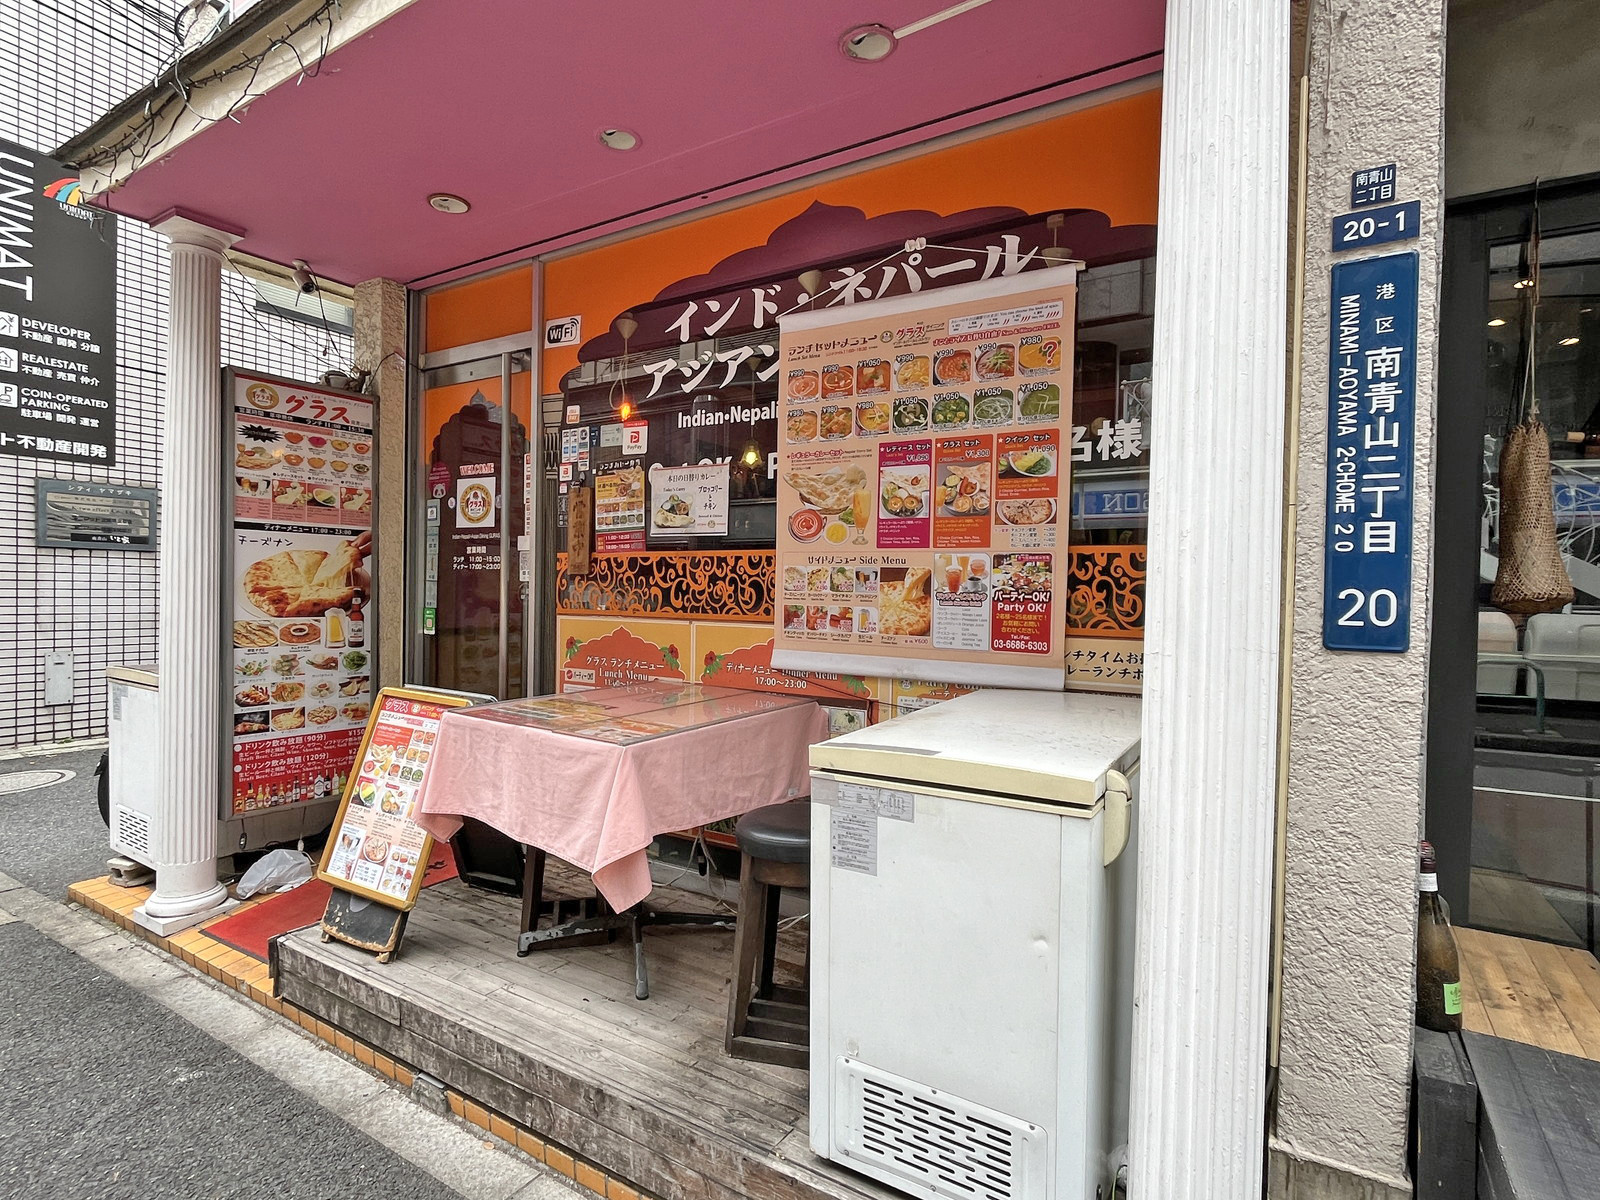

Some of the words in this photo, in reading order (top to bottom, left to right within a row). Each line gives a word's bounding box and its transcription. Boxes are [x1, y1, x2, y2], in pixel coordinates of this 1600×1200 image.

[1356, 168, 1393, 187] 南青山
[1355, 184, 1392, 204] 二丁目
[0, 151, 34, 301] UNIMAT
[1343, 210, 1405, 242] 20-1
[665, 234, 1039, 342] インド・ネパール
[1375, 282, 1396, 335] 港区
[21, 317, 92, 341] DEVELOPER
[896, 326, 925, 340] グラス
[21, 329, 53, 344] 不動産
[56, 337, 77, 349] 開発
[80, 342, 101, 354] 分譲
[1021, 335, 1043, 345] ¥980
[936, 348, 955, 358] ¥990
[978, 342, 997, 354] ¥990
[21, 352, 89, 373] REALESTATE
[896, 353, 914, 362] ¥990
[642, 344, 778, 399] アジアン
[823, 364, 839, 373] ¥990
[1337, 294, 1361, 437] MINAMI-AOYAMA
[21, 364, 53, 379] 不動産
[56, 371, 77, 383] 売買
[79, 375, 100, 387] 仲介
[789, 370, 805, 378] ¥990
[21, 387, 109, 409] COIN-OPERATED
[21, 397, 71, 412] PARKING
[285, 394, 351, 424] グラス
[20, 408, 52, 421] 駐車場
[56, 413, 77, 425] 開発
[79, 417, 99, 428] 運営
[239, 407, 265, 417] 営業時間
[306, 419, 323, 427] ランチ
[0, 432, 108, 458] ト不動産開発
[943, 440, 961, 449] グラス
[963, 439, 981, 448] セット
[1005, 435, 1030, 444] クイック
[1032, 433, 1051, 442] セット
[790, 449, 845, 460] レギュラーカレーセット
[886, 443, 913, 453] レディース
[916, 442, 931, 451] セット
[1029, 444, 1056, 453] ¥1,090
[1361, 346, 1404, 554] 南青山二丁目
[460, 463, 494, 476] WELCOME
[668, 474, 716, 483] 本日の日替りカレー
[1334, 446, 1358, 514] 2-CHOME
[100, 488, 131, 496] ヤマザキ
[698, 485, 723, 493] ブロッコリー
[708, 494, 713, 502] と
[264, 523, 309, 533] ディナーメニュー
[238, 535, 293, 547] チーズナン
[1334, 523, 1355, 553] 20
[466, 545, 486, 554] 営業時間
[808, 556, 857, 565] サイドメニュー
[859, 556, 878, 565] Side
[881, 556, 907, 565] Menu
[994, 591, 1050, 602] パーティーOK!
[998, 603, 1025, 613] Party
[1027, 604, 1047, 613] OK!
[1337, 588, 1398, 628] 20
[993, 639, 1048, 651] 03-6686-6303
[586, 656, 608, 666] グラス
[610, 657, 665, 670] ランチメニュー
[726, 662, 778, 675] ディナーメニュー
[599, 668, 623, 679] Lunch
[626, 670, 649, 681] Menu
[385, 698, 410, 713] グラス
[245, 734, 327, 751] ドリンク飲み放題(90分)
[245, 752, 329, 771] ドリンク飲み放題(120分)
